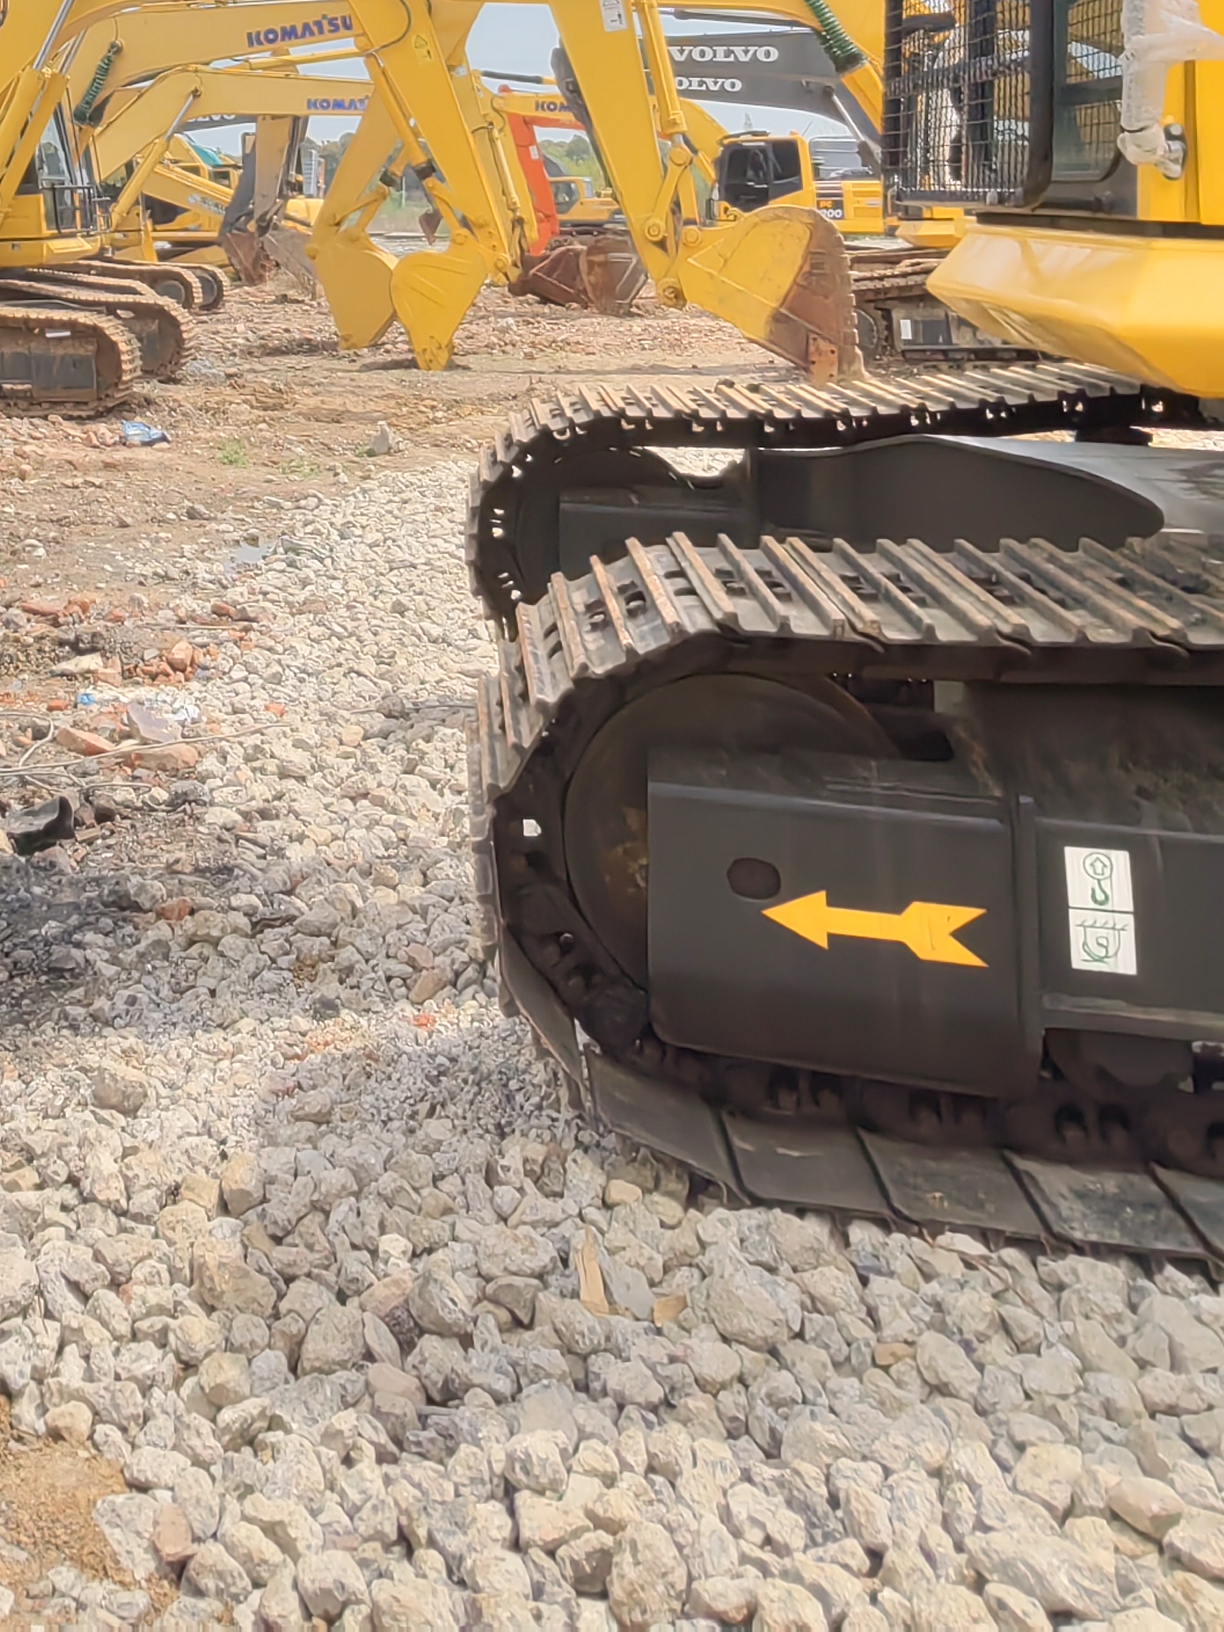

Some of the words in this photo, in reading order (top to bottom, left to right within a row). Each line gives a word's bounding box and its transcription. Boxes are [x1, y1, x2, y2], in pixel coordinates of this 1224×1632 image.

[246, 14, 354, 48] KOMATSU
[667, 45, 779, 63] VOLVO
[673, 76, 743, 93] OLVO
